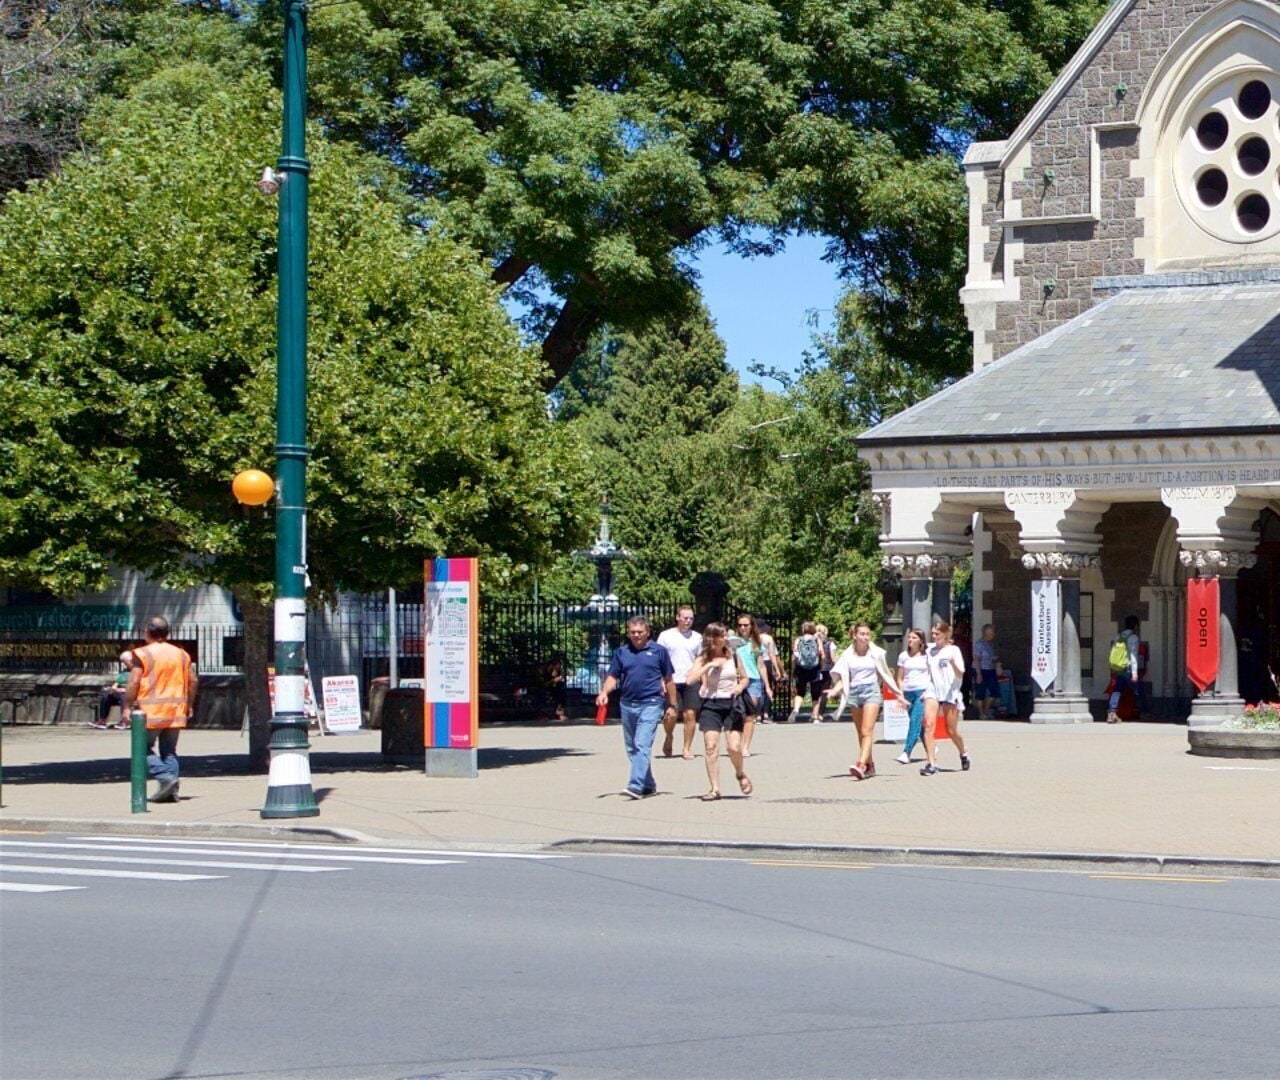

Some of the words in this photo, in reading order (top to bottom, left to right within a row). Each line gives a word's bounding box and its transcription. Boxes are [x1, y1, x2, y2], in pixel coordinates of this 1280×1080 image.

[951, 476, 978, 487] THESE
[981, 476, 997, 487] ARE
[1001, 475, 1028, 486] PARTS
[1032, 475, 1042, 486] OF
[1044, 473, 1062, 486] HIS
[1065, 473, 1090, 485] WAYS
[1093, 473, 1111, 484] BUT
[1114, 472, 1134, 484] HOW
[1138, 471, 1172, 483] LITTLE
[1175, 471, 1182, 482] A
[1185, 470, 1224, 482] PORTION
[1227, 470, 1236, 481] IS
[1239, 469, 1269, 481] HEARD
[1037, 593, 1045, 655] Canterbury
[1197, 607, 1208, 648] open
